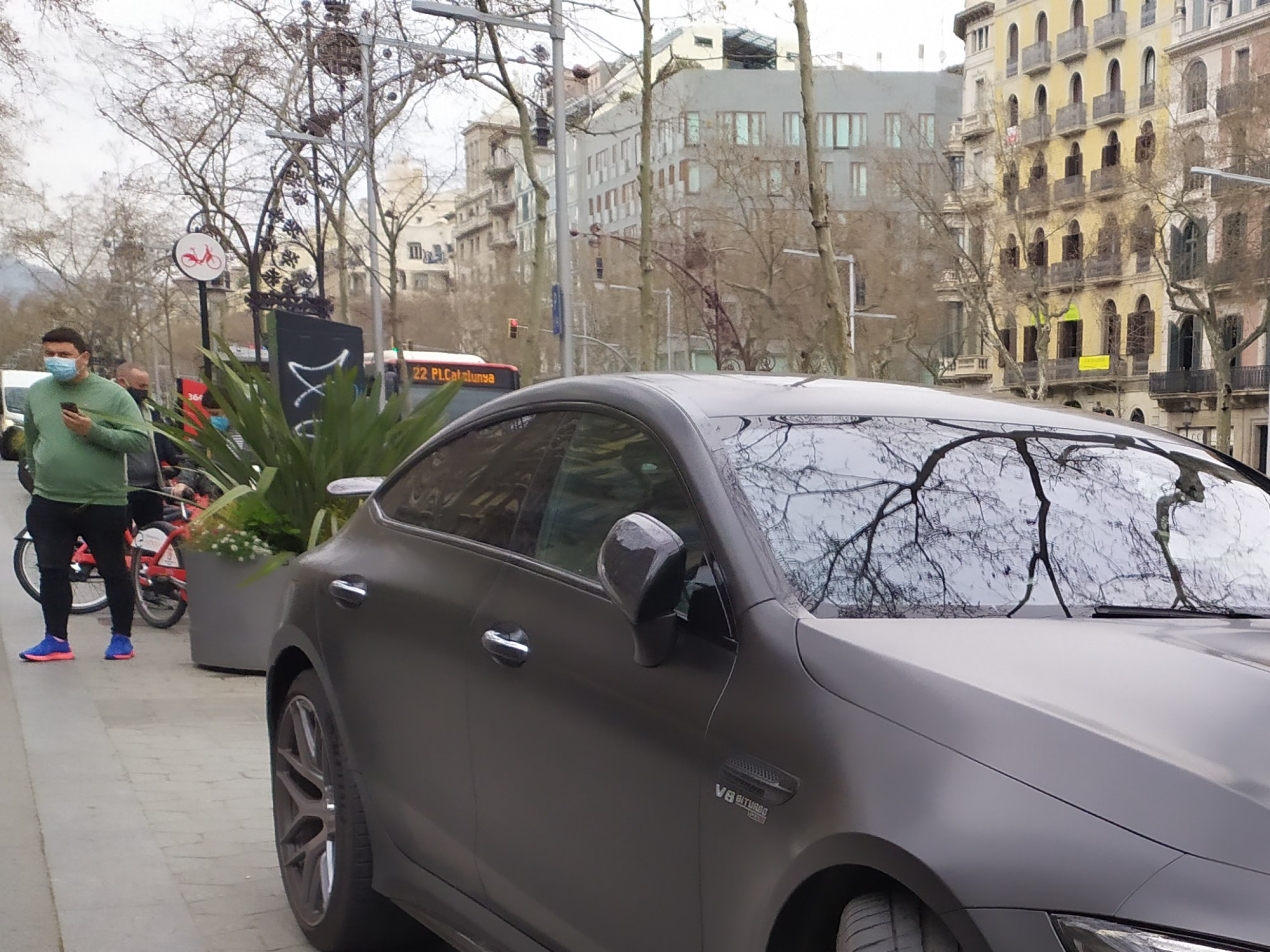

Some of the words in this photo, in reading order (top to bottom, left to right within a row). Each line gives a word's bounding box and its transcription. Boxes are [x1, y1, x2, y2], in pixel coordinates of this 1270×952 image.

[413, 366, 428, 380] 22
[715, 783, 736, 803] V8
[735, 794, 768, 816] BITURBO
